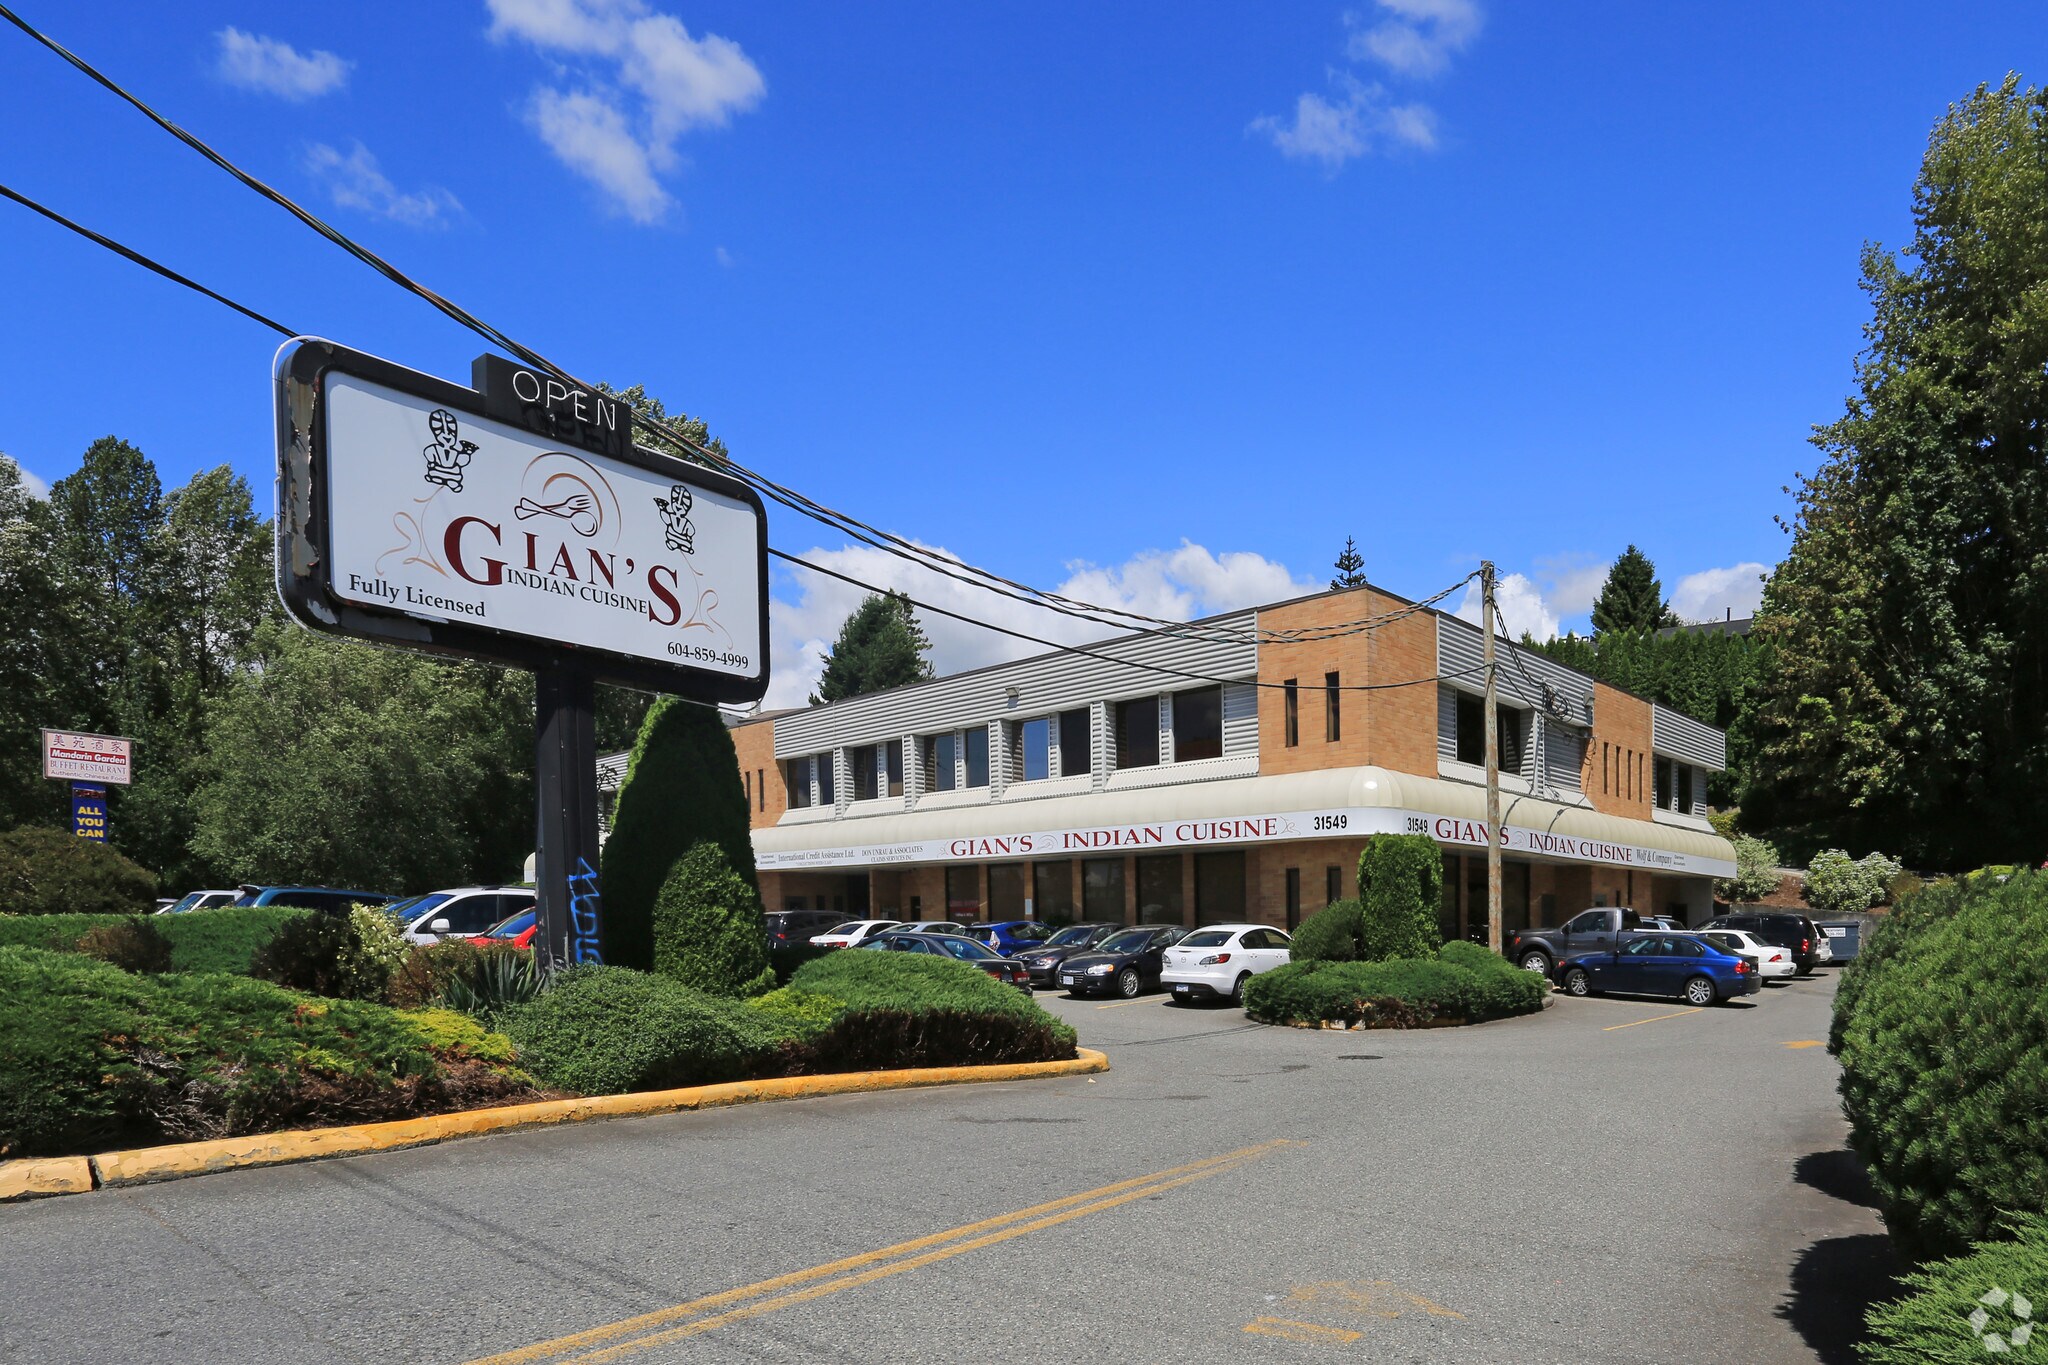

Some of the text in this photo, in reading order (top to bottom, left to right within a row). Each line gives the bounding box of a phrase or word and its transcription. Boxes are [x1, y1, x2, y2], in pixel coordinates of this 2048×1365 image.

[512, 370, 616, 431] OPEN
[443, 516, 681, 626] GIAN'S
[349, 573, 486, 617] Fully Licensed
[507, 567, 648, 615] INDIAN CUISINE
[667, 641, 749, 670] 604-859-4999
[50, 760, 126, 775] BUFFET RESTAURANT
[51, 749, 125, 764] Mandarin Garden
[76, 818, 104, 827] YOU
[78, 806, 102, 815] ALL
[1313, 814, 1348, 831] 31549
[76, 829, 104, 838] CAN
[1063, 817, 1278, 849] INDIAN CUISINE
[1407, 817, 1428, 833] 31549
[1435, 818, 1510, 846] GIANS
[950, 835, 1033, 856] GIAN'S
[1529, 833, 1632, 863] INDIAN CUISINE
